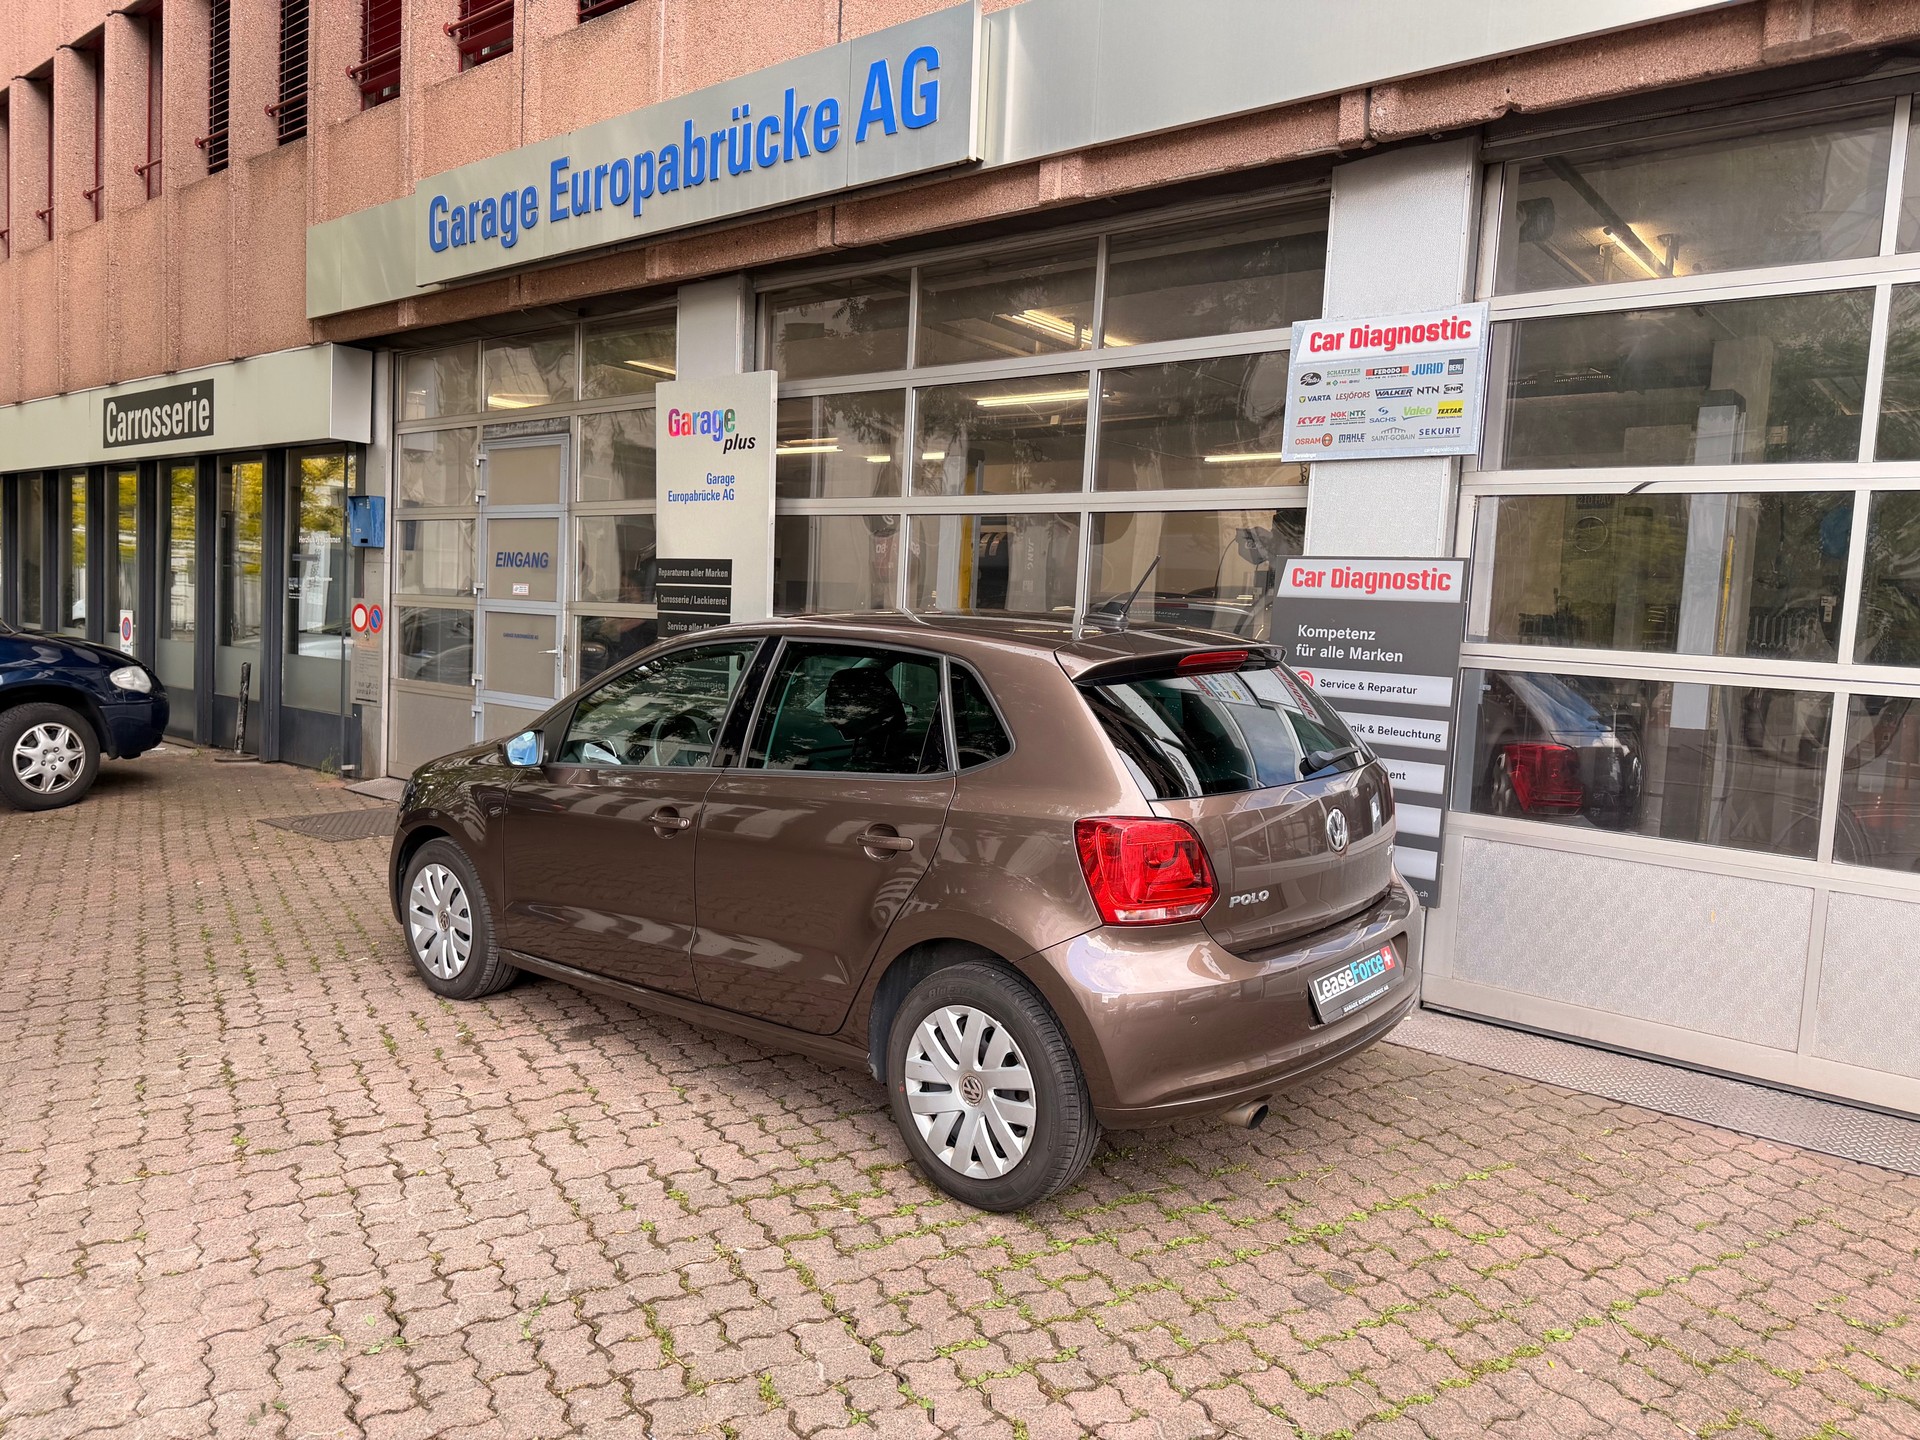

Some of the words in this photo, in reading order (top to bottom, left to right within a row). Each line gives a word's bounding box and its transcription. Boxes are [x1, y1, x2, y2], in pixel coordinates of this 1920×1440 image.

[428, 185, 539, 253] Garage
[549, 87, 841, 217] Europabrücke
[855, 45, 941, 143] AG
[1309, 331, 1344, 353] Car
[1349, 315, 1472, 351] Diagnostic
[1374, 367, 1401, 375] FERODO
[1411, 362, 1444, 376] JURID
[1375, 389, 1413, 397] WALKER
[1417, 386, 1440, 395] NTN
[106, 387, 210, 443] Carrosserie
[1403, 406, 1432, 416] Valeo
[668, 408, 736, 441] Garage
[1297, 416, 1327, 424] KYB
[1339, 433, 1365, 441] MAHLE
[1371, 434, 1416, 442] SAINT-GOBAIN
[1419, 427, 1461, 436] SEKURIT
[723, 433, 756, 454] plus
[706, 472, 735, 487] Garage
[668, 489, 721, 504] Europabrücke
[722, 488, 735, 501] AG
[495, 551, 549, 569] EINGANG
[658, 567, 690, 578] Reparaturen
[690, 568, 704, 577] aller
[705, 568, 729, 578] Marken
[1291, 567, 1326, 588] Car
[1330, 566, 1452, 595] Diagnostic
[660, 594, 690, 604] Carrosserie
[694, 595, 728, 606] Lackiererei
[667, 621, 688, 631] Service
[688, 623, 703, 631] aller
[1297, 624, 1376, 641] Kompetenz
[1295, 643, 1316, 658] für
[1320, 645, 1344, 659] alle
[1349, 646, 1403, 662] Marken
[1320, 678, 1356, 690] Service
[1358, 682, 1364, 690] &
[1367, 682, 1418, 694] Reparatur
[1351, 723, 1366, 733] nik
[1368, 725, 1375, 734] &
[1377, 725, 1442, 743] Beleuchtung
[1389, 771, 1406, 780] ent
[1229, 889, 1270, 908] POLO
[1313, 953, 1385, 1003] LeaseForce
